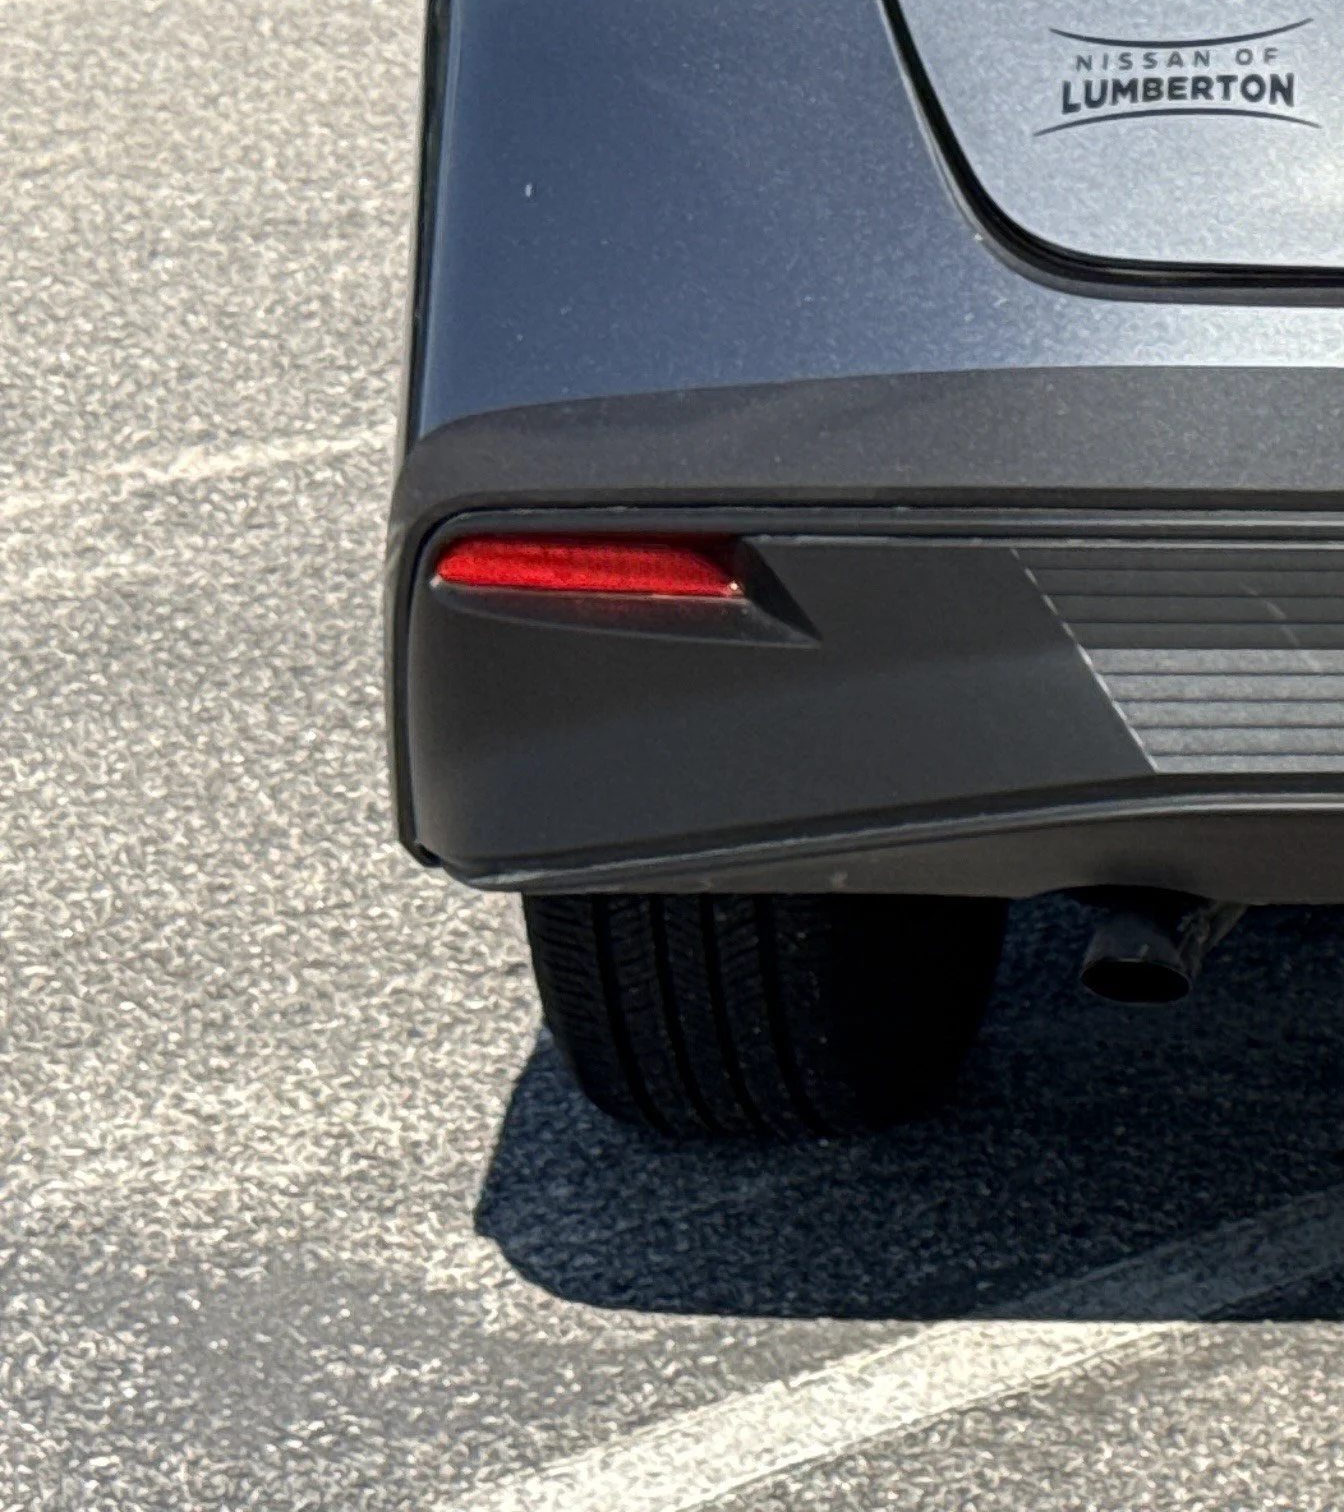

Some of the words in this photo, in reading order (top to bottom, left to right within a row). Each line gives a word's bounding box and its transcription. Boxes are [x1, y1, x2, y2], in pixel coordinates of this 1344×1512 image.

[1075, 49, 1211, 72] NISSAN
[1234, 47, 1280, 67] OF
[1061, 72, 1296, 115] LUMBERTON
